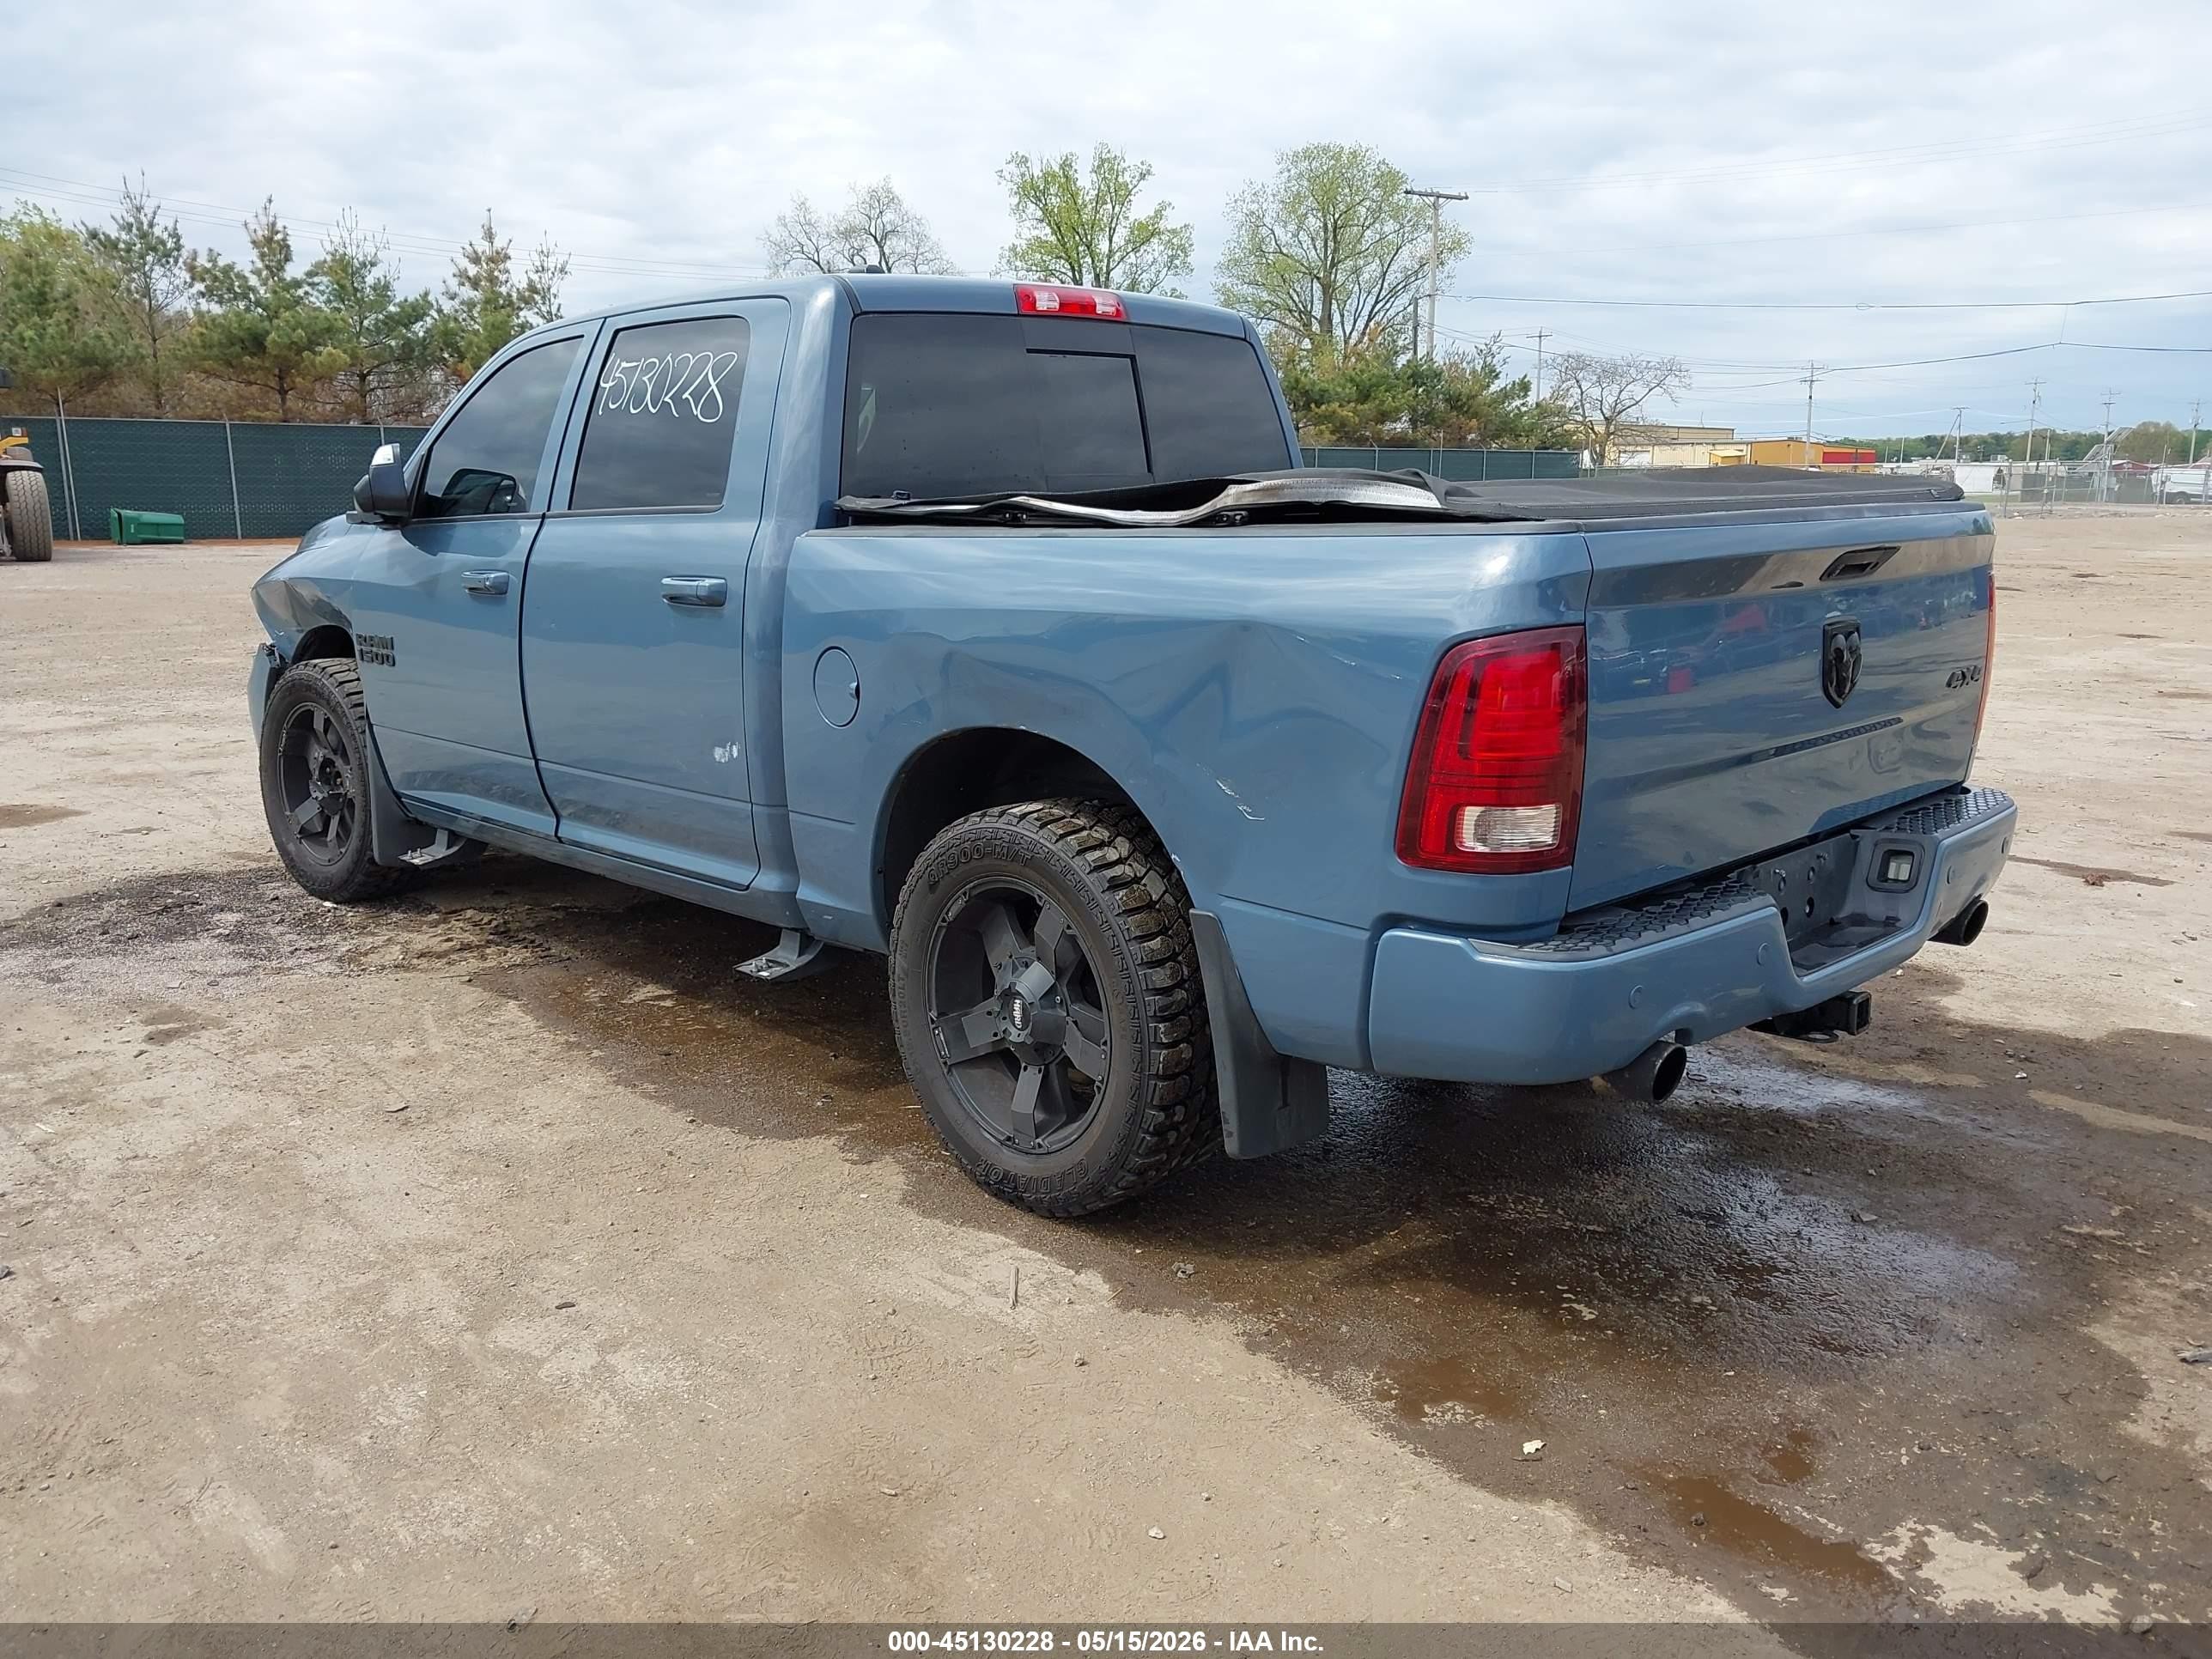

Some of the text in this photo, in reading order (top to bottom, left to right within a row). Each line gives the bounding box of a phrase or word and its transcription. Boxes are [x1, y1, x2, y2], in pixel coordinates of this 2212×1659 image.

[599, 351, 738, 423] 45130228
[355, 633, 394, 651] RAM
[357, 647, 396, 667] 1500
[975, 1157, 1090, 1194] GLADIATOR
